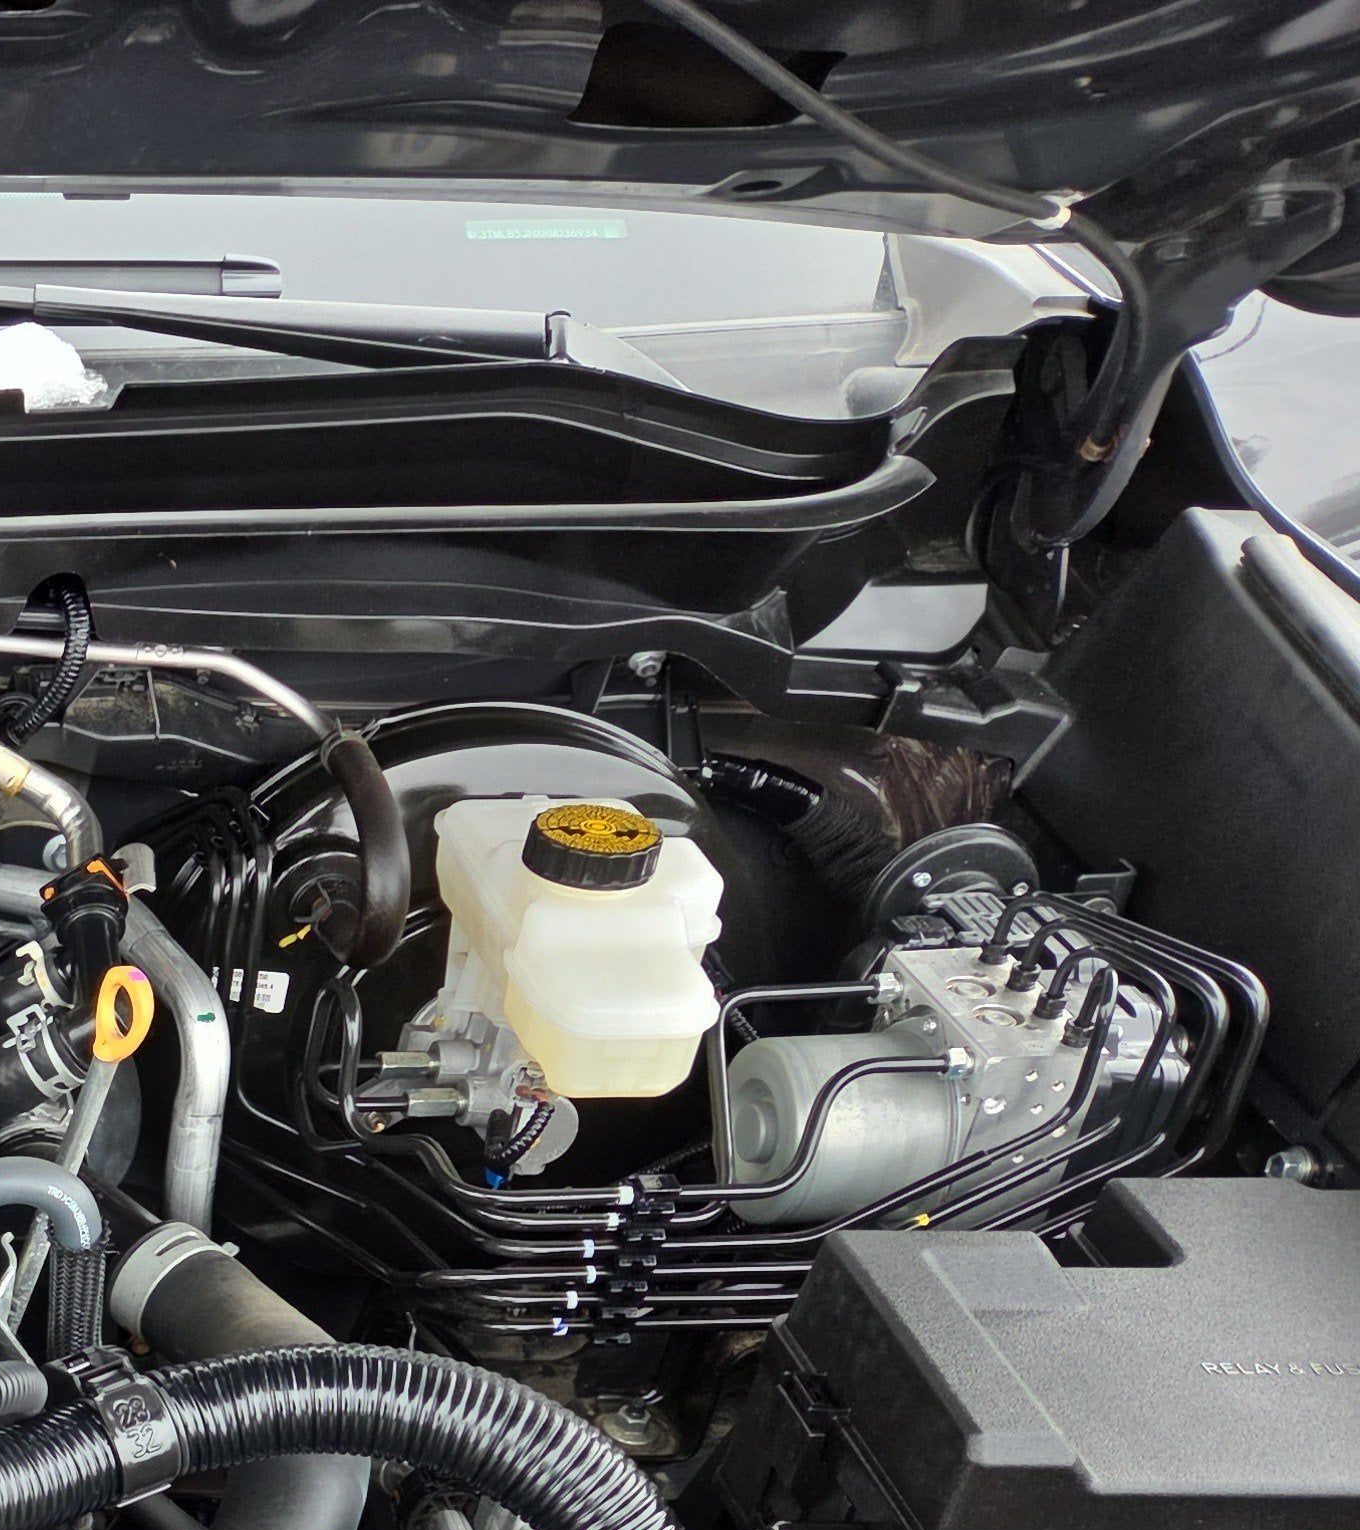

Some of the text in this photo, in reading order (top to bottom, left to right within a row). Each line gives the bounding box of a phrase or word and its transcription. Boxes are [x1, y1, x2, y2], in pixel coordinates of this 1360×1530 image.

[1201, 1361, 1281, 1376] RELAY
[1288, 1363, 1306, 1375] &
[126, 1424, 163, 1459] 32
